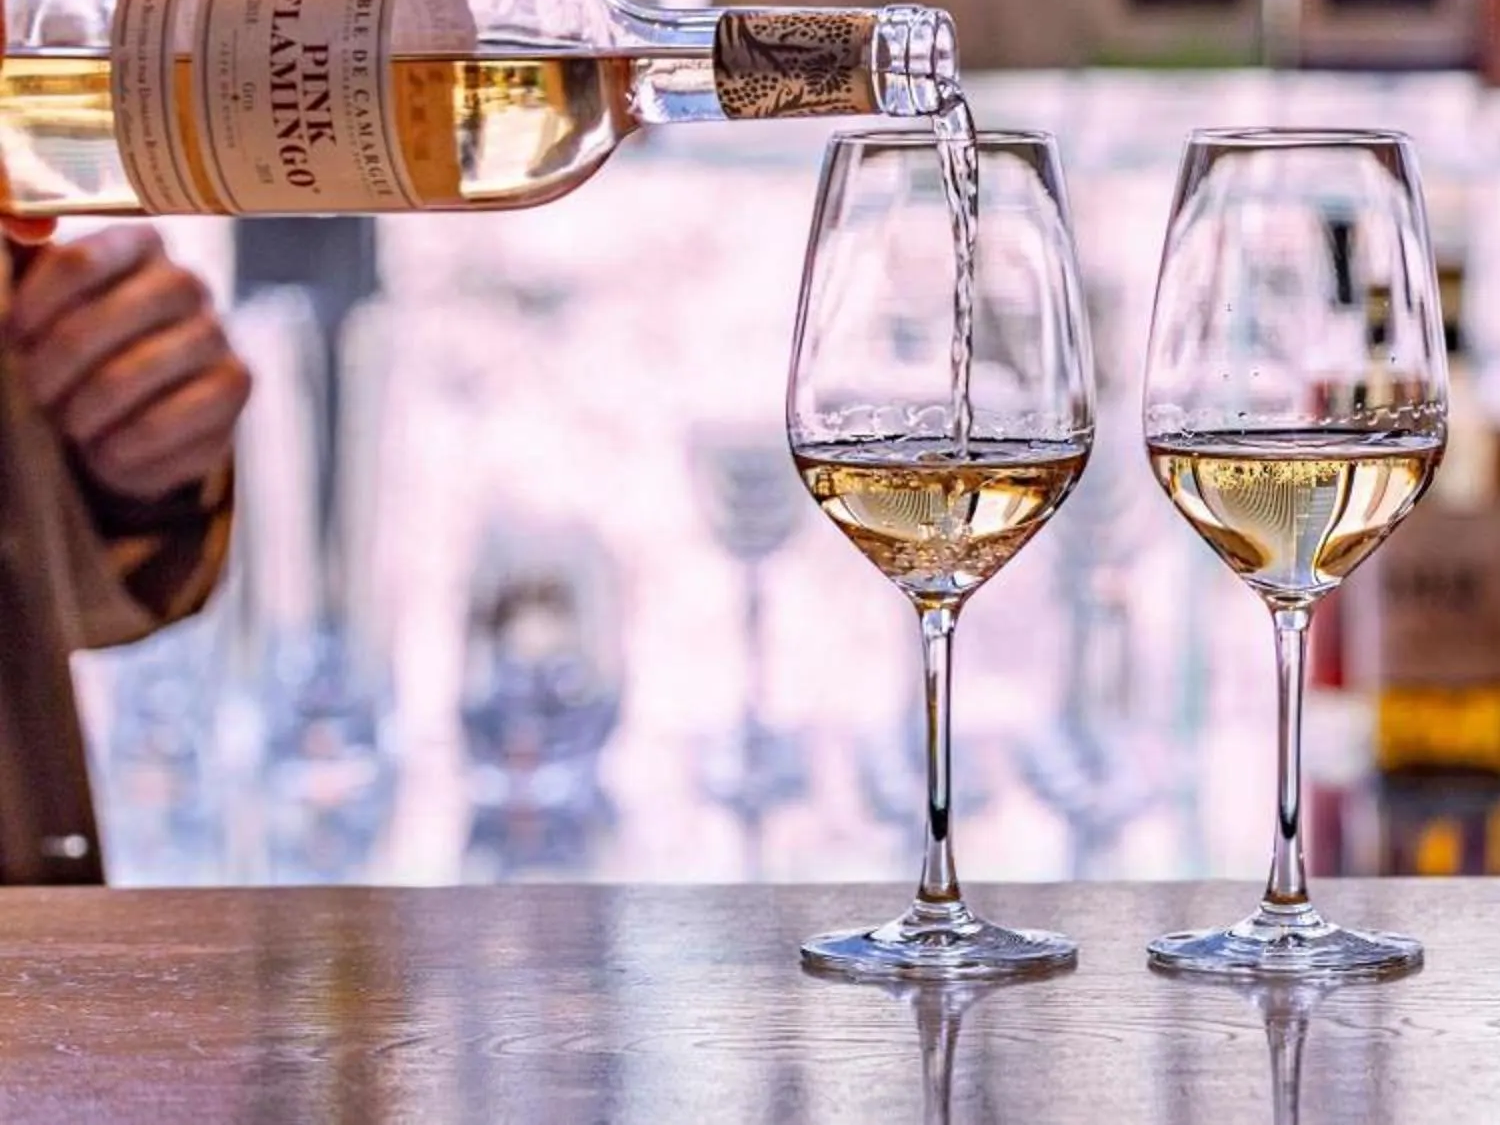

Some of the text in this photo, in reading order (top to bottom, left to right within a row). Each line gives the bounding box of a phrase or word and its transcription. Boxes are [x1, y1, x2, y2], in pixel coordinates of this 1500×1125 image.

[302, 43, 337, 147] PINK
[352, 49, 369, 78] DE
[353, 88, 394, 196] CAMARGUE
